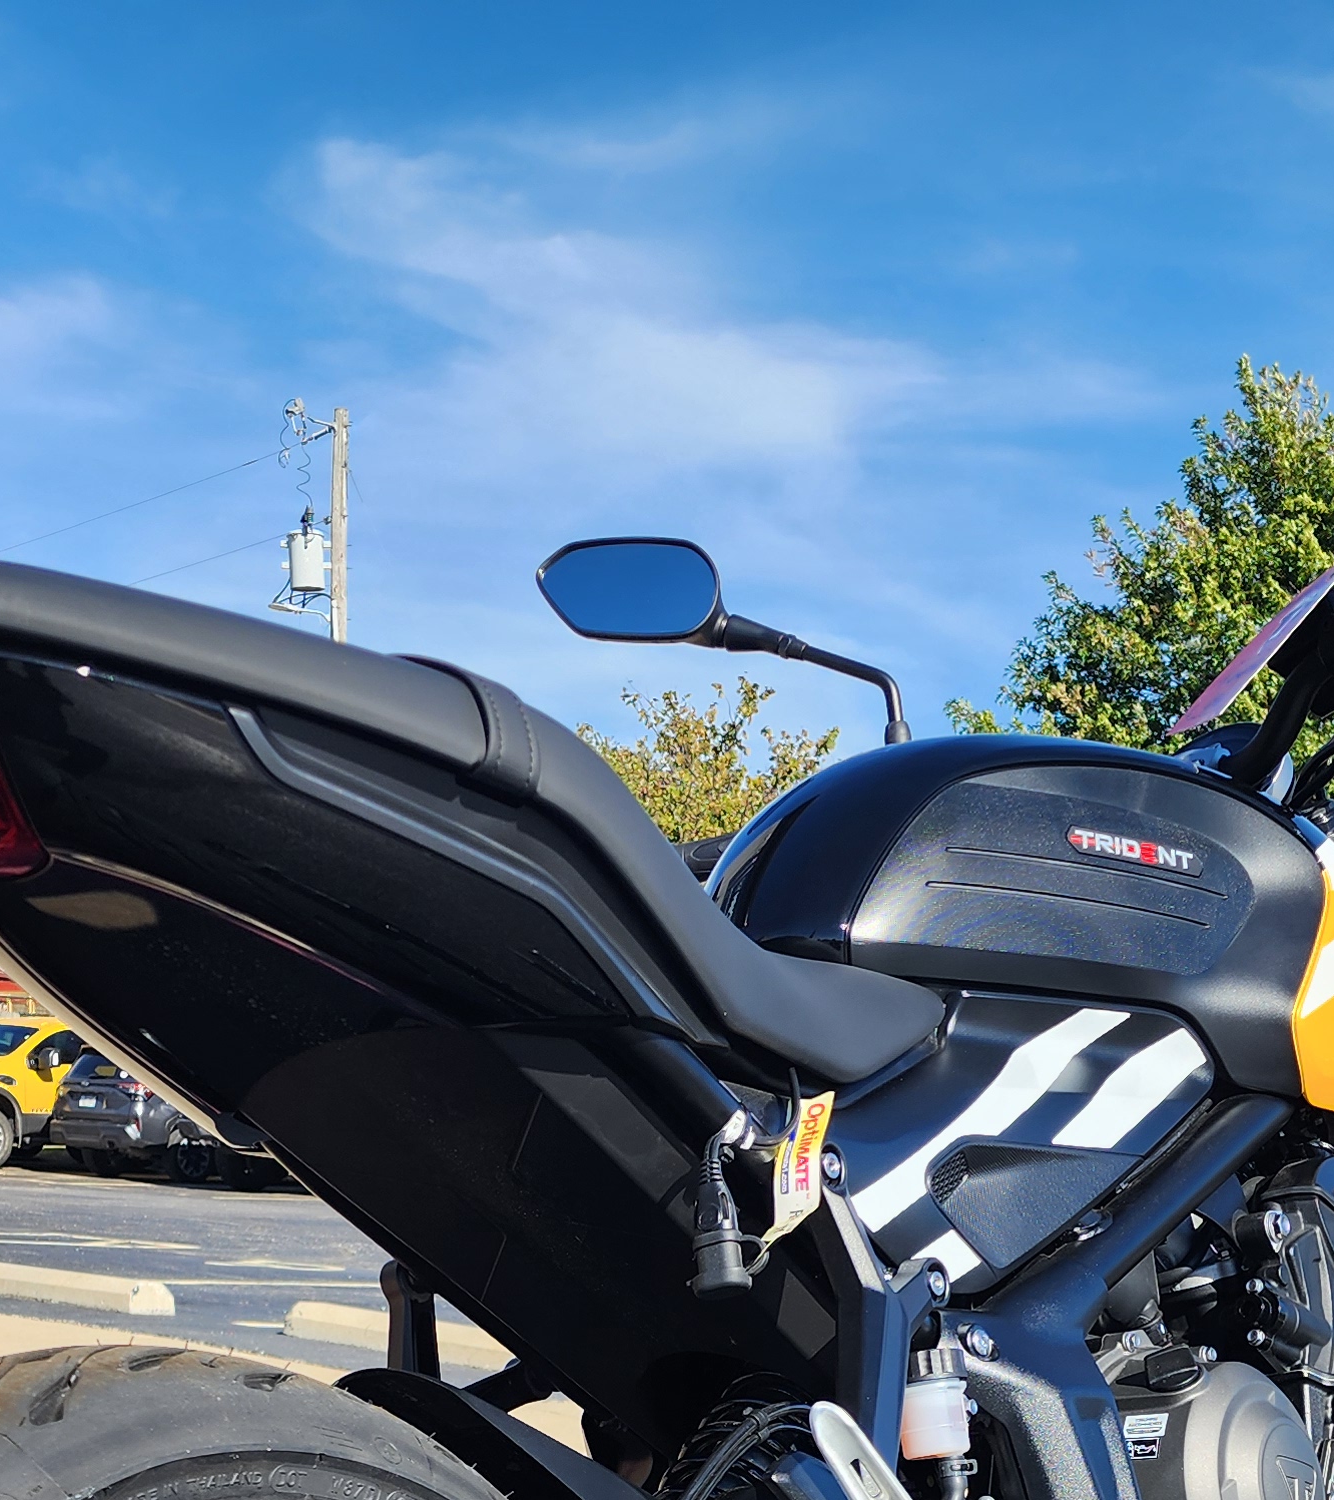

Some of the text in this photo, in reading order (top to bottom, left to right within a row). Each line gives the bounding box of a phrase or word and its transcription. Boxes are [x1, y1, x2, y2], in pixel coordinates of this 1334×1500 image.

[1071, 828, 1194, 871] TRIDENT
[794, 1102, 826, 1193] OptiMATE
[163, 1480, 180, 1498] IN
[185, 1470, 264, 1494] THAILAND
[276, 1469, 307, 1488] DOT
